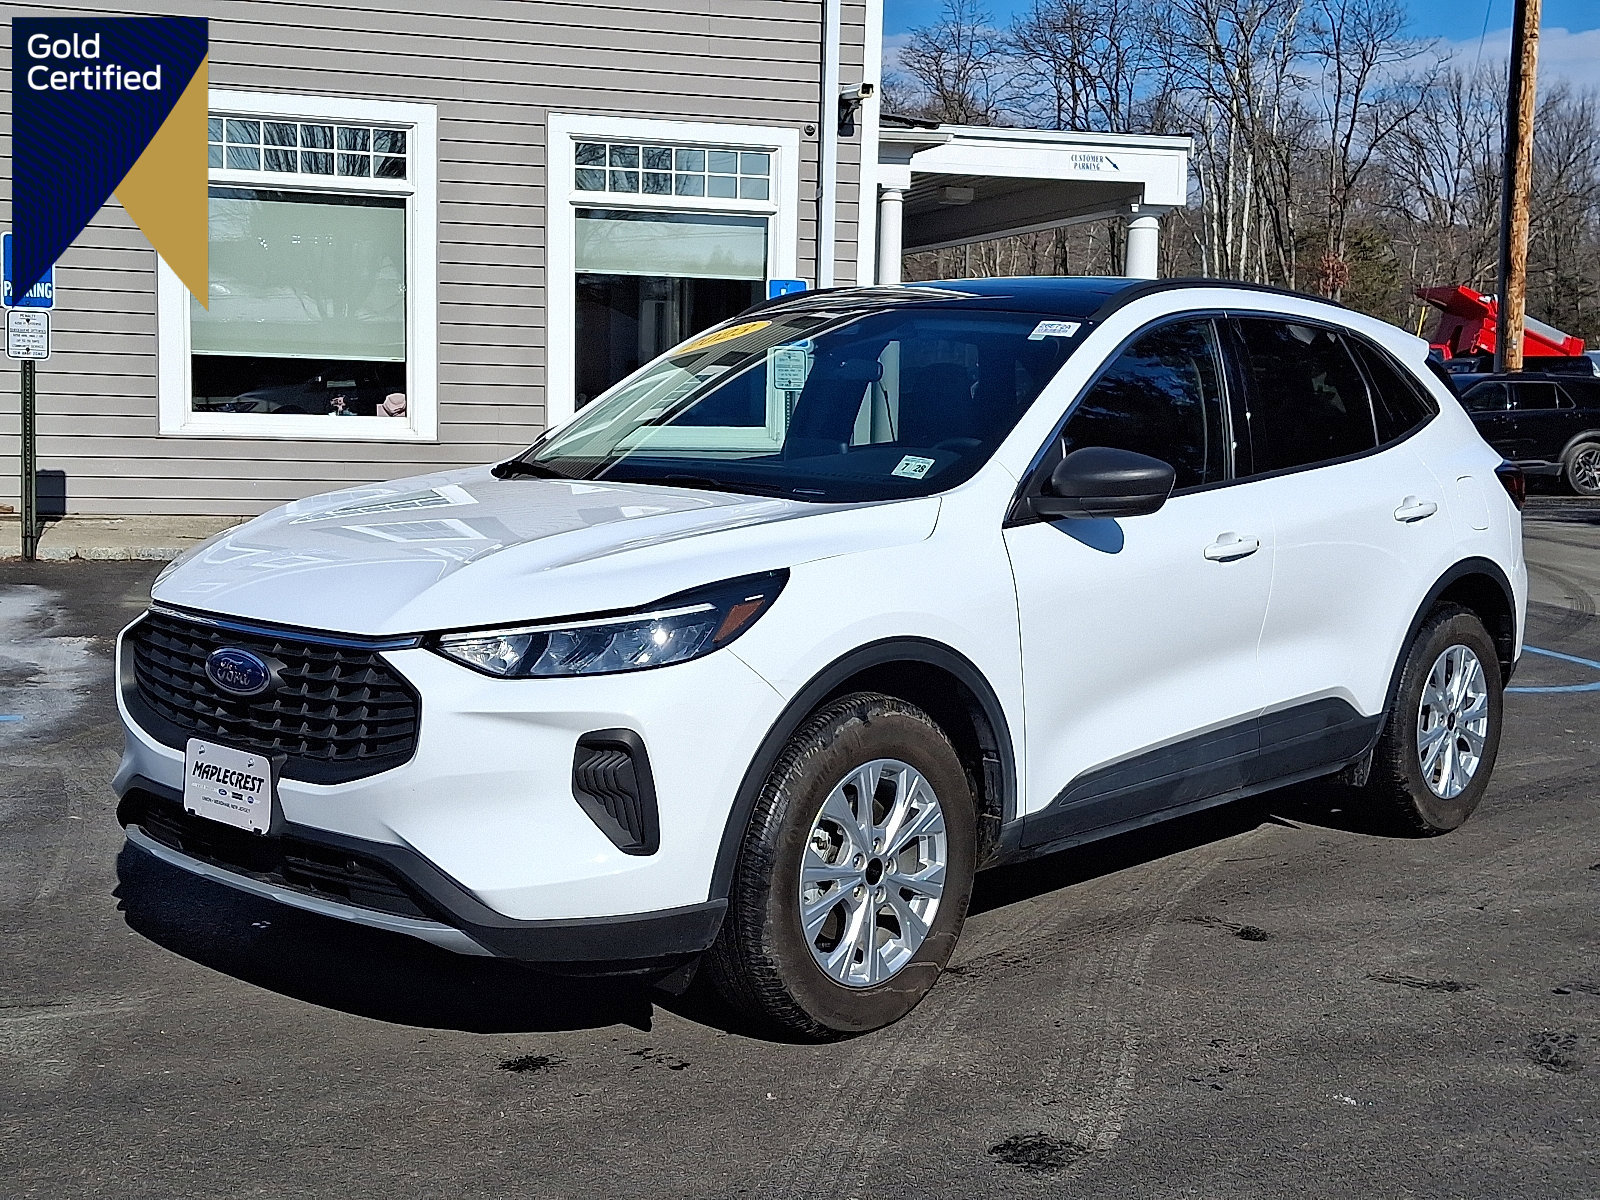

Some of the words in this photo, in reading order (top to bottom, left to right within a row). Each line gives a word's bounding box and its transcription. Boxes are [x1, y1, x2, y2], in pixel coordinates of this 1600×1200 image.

[1071, 154, 1104, 163] CUSTOMER
[1073, 162, 1100, 171] PARKING
[4, 280, 53, 298] PING
[901, 462, 910, 471] 7
[913, 464, 927, 473] 28
[217, 657, 253, 686] Ford
[191, 760, 265, 794] MAPLECREST
